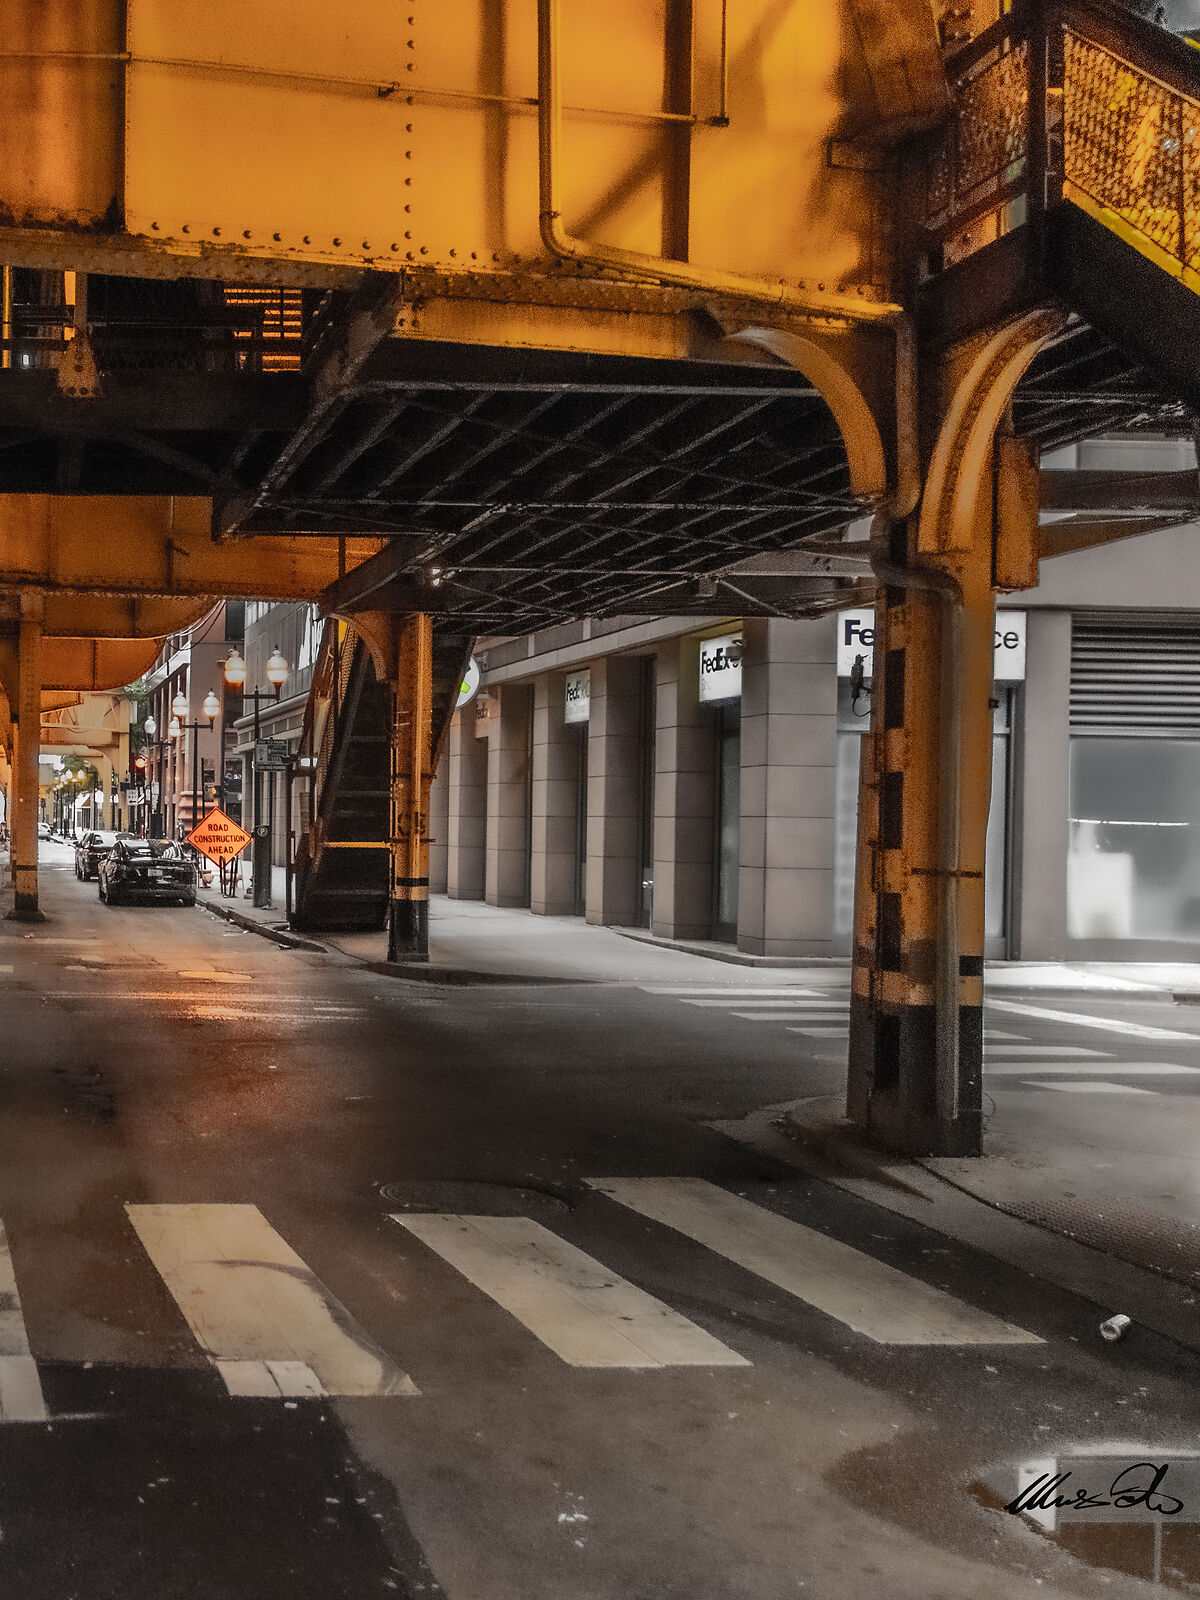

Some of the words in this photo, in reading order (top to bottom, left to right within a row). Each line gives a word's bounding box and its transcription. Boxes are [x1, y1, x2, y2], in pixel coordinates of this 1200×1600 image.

[701, 647, 730, 675] FedEx
[208, 823, 229, 832] ROAD
[193, 835, 245, 843] CONSTRUCTION
[208, 846, 234, 854] AHEAD
